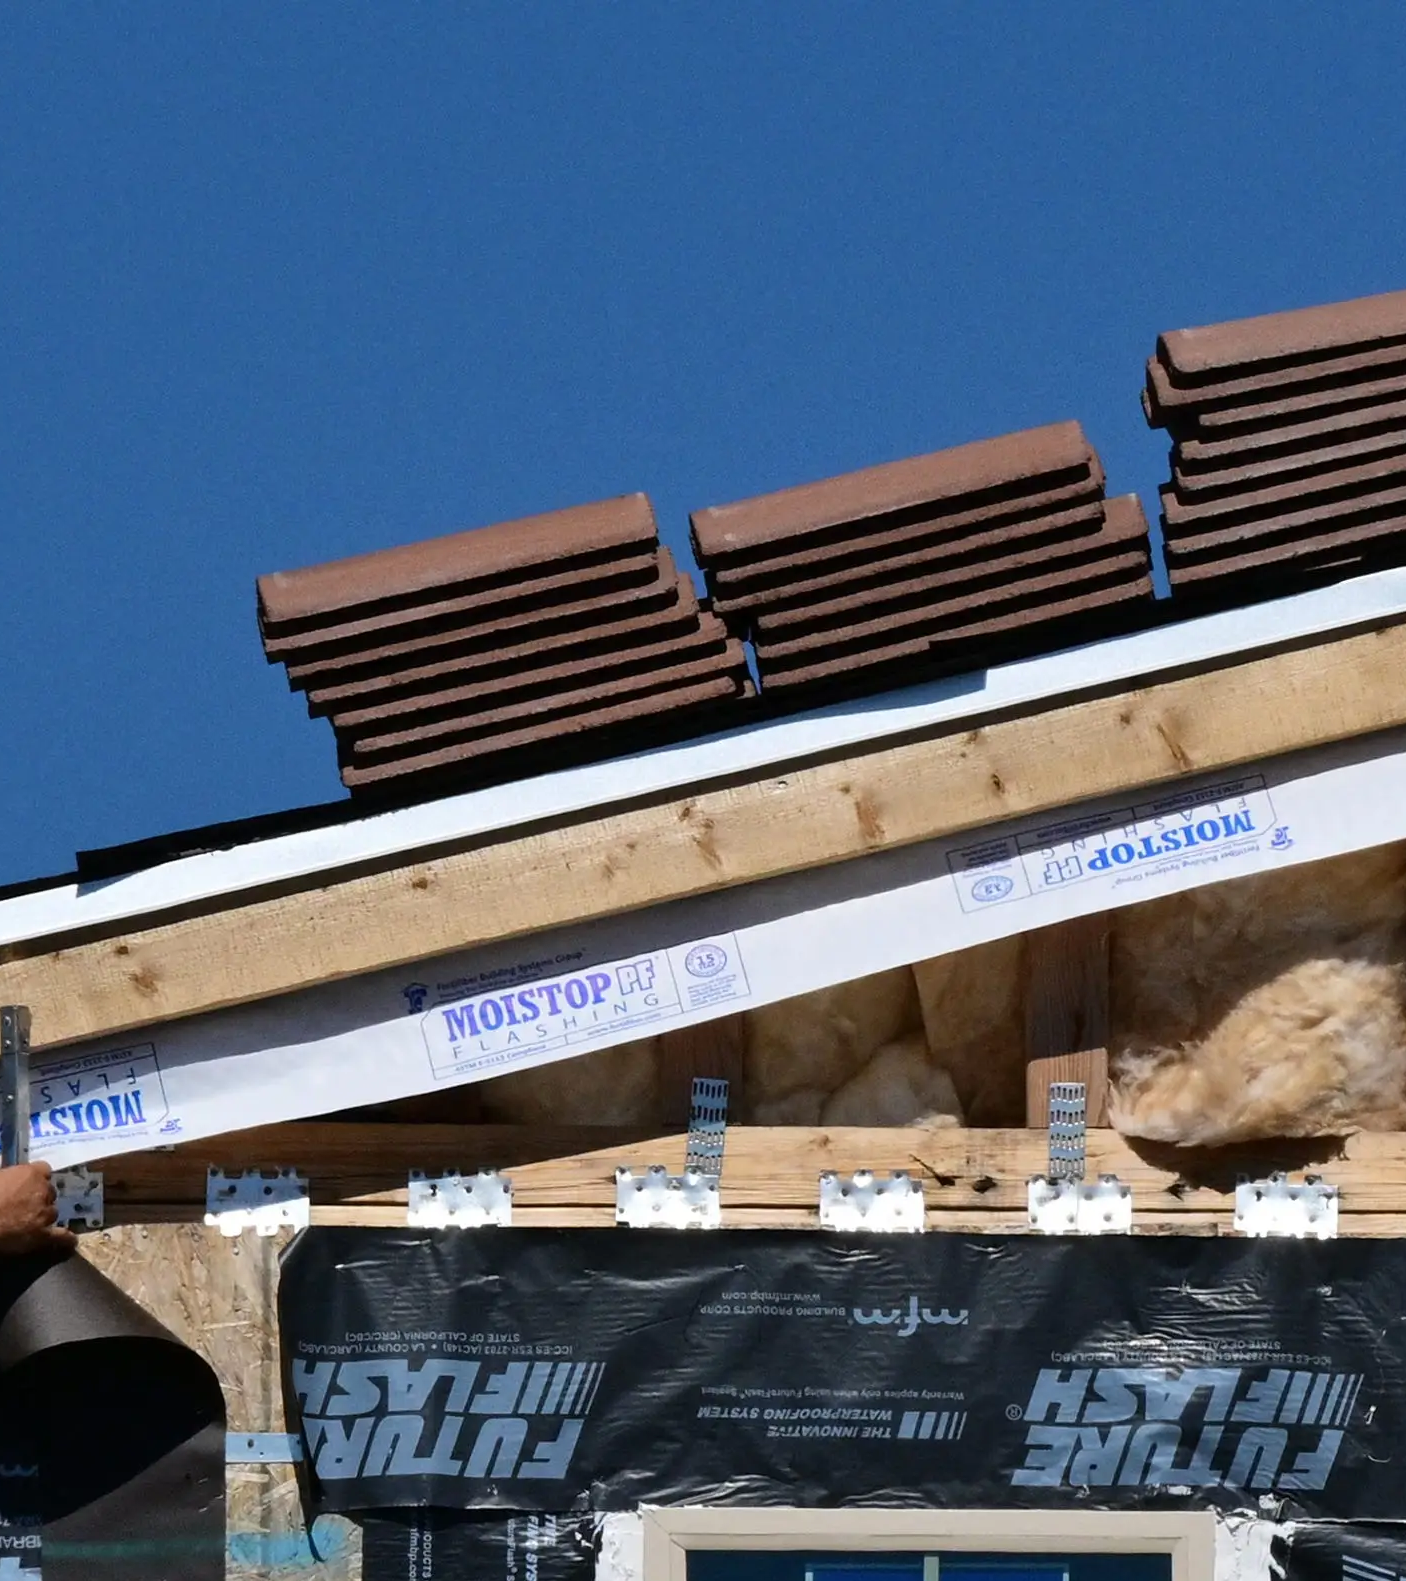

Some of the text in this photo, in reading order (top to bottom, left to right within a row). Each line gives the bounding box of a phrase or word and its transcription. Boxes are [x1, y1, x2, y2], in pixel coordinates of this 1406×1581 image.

[1087, 808, 1255, 872] MOISTOP
[441, 972, 612, 1042] MOISTOP
[452, 993, 660, 1060] FLASHING
[697, 1302, 845, 1315] BUILDING PRODUCTS CORP.
[852, 1295, 968, 1336] mfm
[696, 1405, 892, 1420] WATERPROOFING SYSTEM
[861, 1424, 891, 1438] THE
[1010, 1425, 1343, 1490] FUTURE
